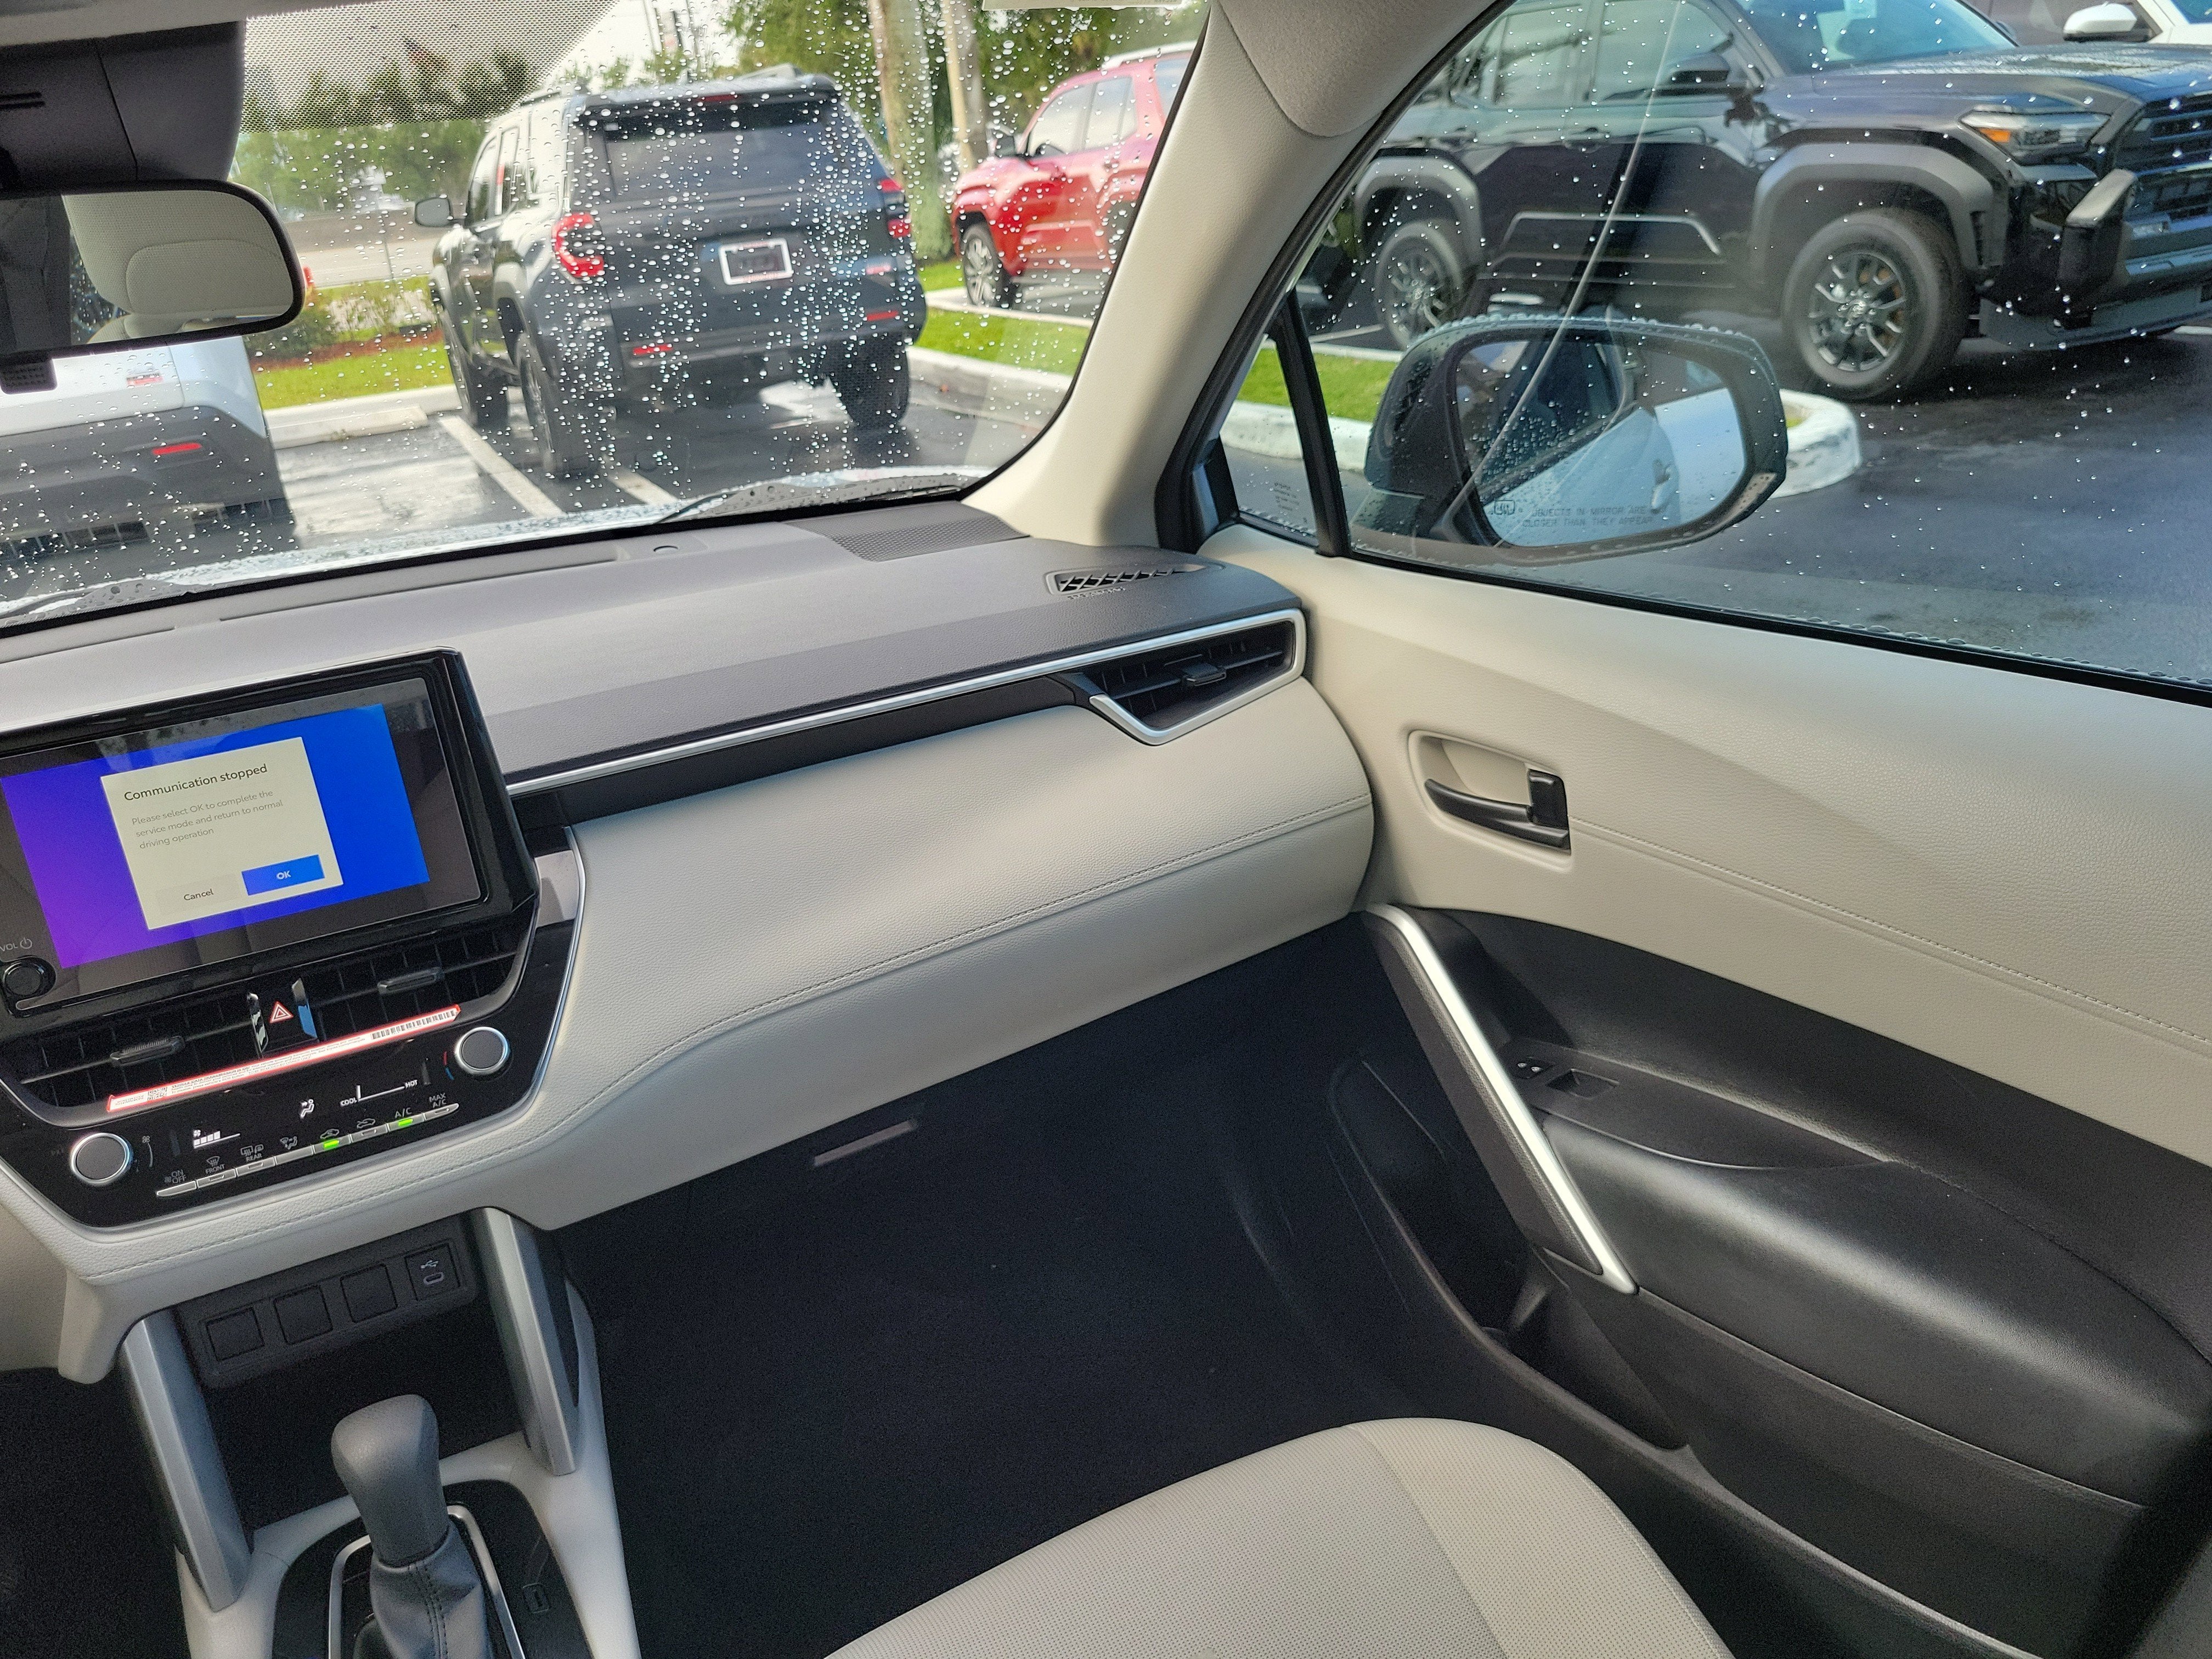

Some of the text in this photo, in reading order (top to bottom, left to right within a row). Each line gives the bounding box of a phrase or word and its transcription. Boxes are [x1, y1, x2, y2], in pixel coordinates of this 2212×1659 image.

[1531, 508, 1571, 517] OBJECTS
[1590, 506, 1623, 515] MIRROR
[1628, 505, 1646, 515] ARE
[1522, 518, 1557, 528] CLOSER
[1592, 517, 1615, 526] THEY
[1619, 515, 1654, 525] APPEAR
[124, 764, 267, 800] Communication stopped
[132, 815, 161, 825] Please
[162, 808, 188, 819] select
[190, 804, 204, 812] OK
[217, 795, 257, 809] complete
[136, 825, 166, 837] service
[168, 820, 194, 830] mode
[195, 815, 212, 825] and
[214, 810, 240, 820] return
[253, 799, 283, 812] normal
[139, 828, 214, 849] driving operation
[276, 870, 291, 879] OK
[183, 888, 214, 901] Cancel
[0, 943, 18, 952] VOL
[404, 1079, 418, 1089] HOT
[340, 1097, 357, 1107] COOL
[429, 1092, 447, 1103] MAX
[432, 1099, 447, 1108] A/C
[394, 1107, 413, 1119] A/C
[246, 1153, 262, 1162] REAR
[171, 1169, 184, 1178] ON
[205, 1164, 225, 1175] FRONT
[172, 1174, 187, 1183] OFF
